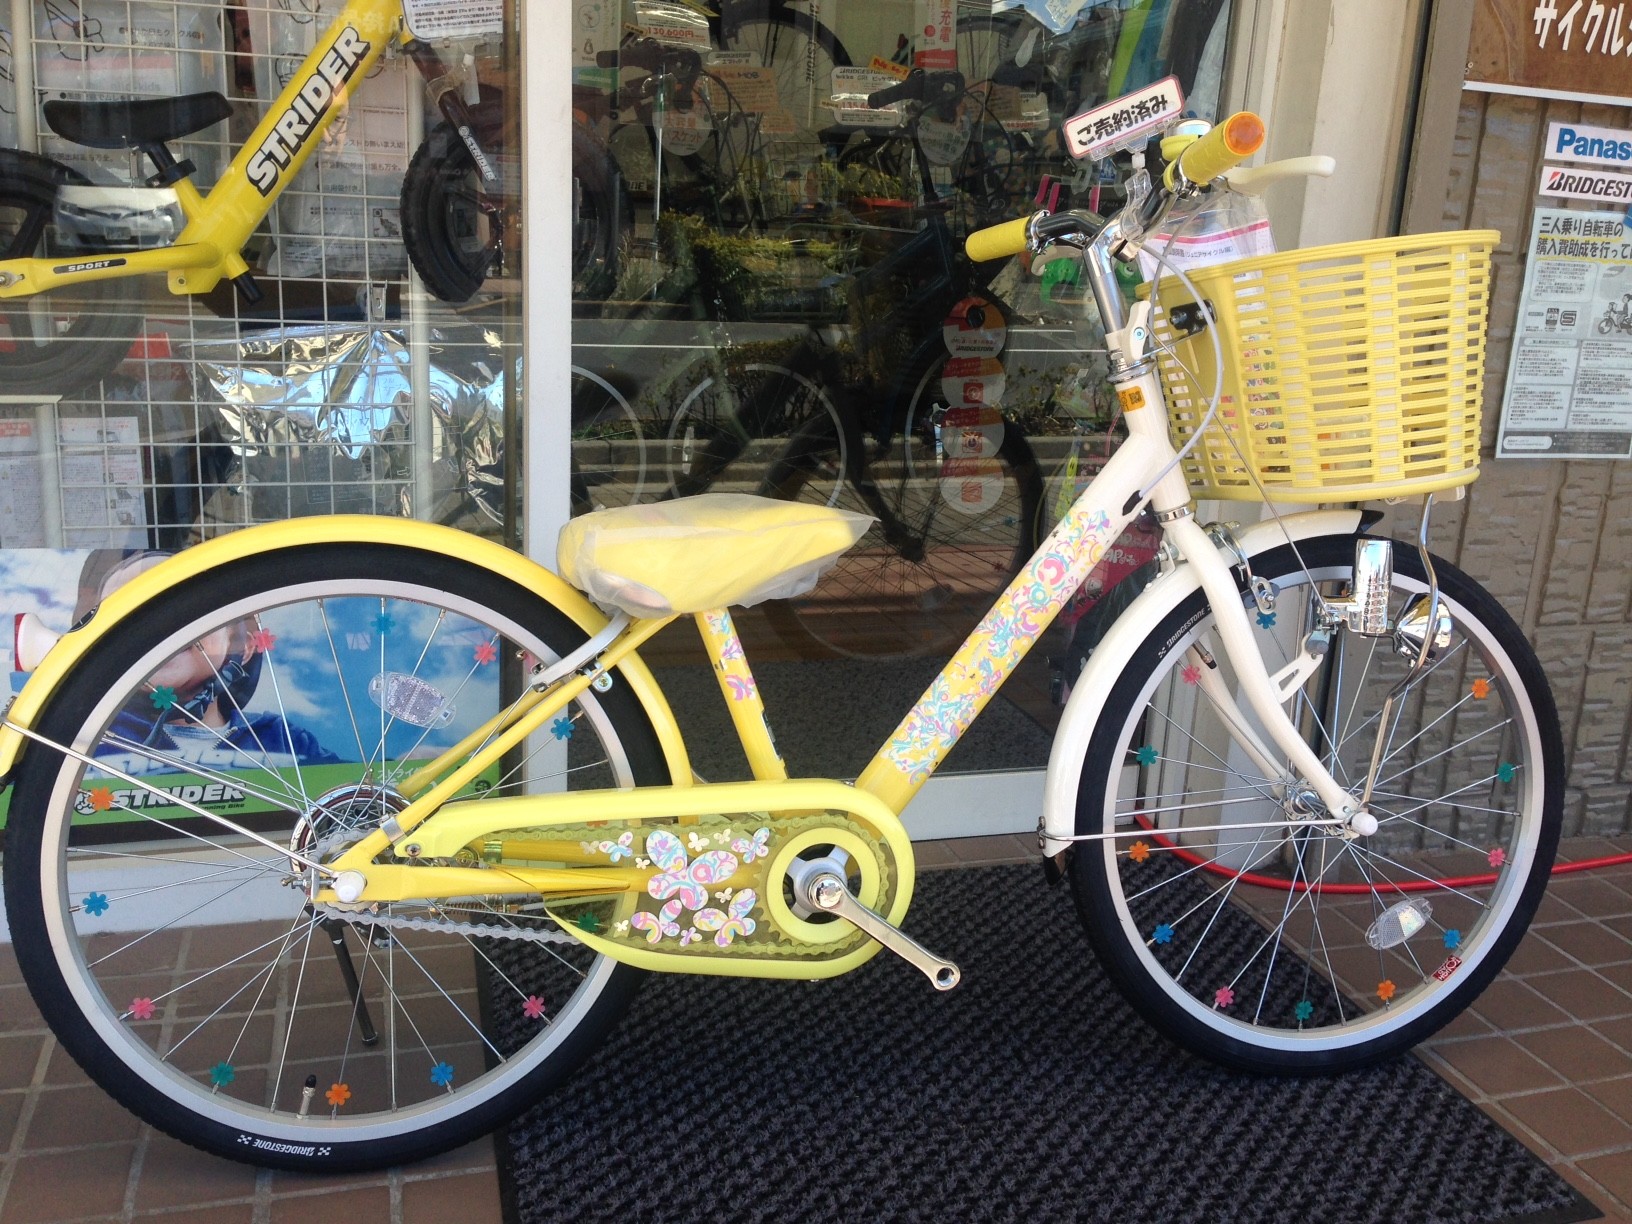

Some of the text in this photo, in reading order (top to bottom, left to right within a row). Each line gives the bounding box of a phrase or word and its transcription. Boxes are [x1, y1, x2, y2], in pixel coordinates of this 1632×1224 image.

[246, 26, 371, 197] STRIDER
[1077, 94, 1169, 146] ご売約済み
[464, 133, 498, 182] STRIDER
[1556, 127, 1632, 161] Panas
[1546, 171, 1632, 199] BRIDGEST
[1540, 216, 1624, 238] 三人乗り自転車の
[1536, 236, 1632, 259] 購入費助成を行って
[68, 260, 111, 273] SPORT
[1166, 607, 1205, 648] BRIDGESTONE
[111, 782, 247, 809] STRIDER
[252, 1138, 316, 1157] BRIDGESTONE
